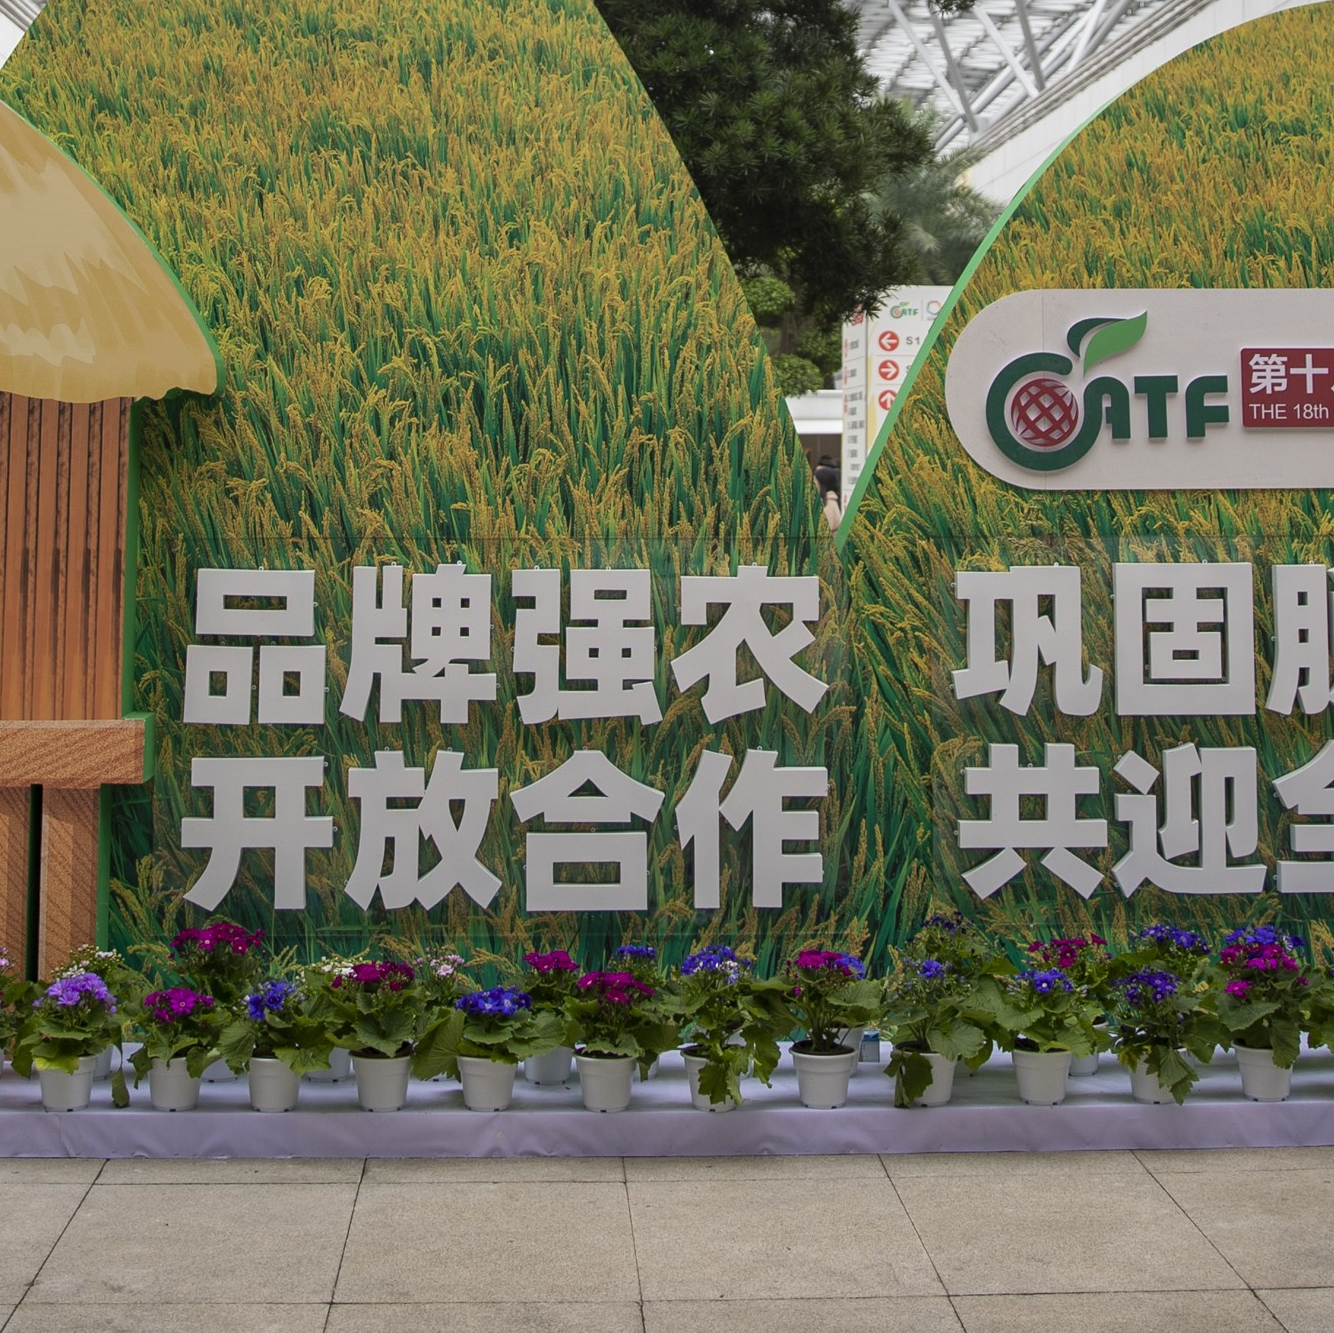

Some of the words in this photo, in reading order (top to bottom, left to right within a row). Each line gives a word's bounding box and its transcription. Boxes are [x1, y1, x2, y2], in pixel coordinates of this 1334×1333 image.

[906, 336, 921, 346] S1
[1248, 403, 1288, 421] THE
[1293, 403, 1329, 420] 18th
[182, 563, 830, 727] 品牌强农
[180, 748, 830, 911] 开放合作
